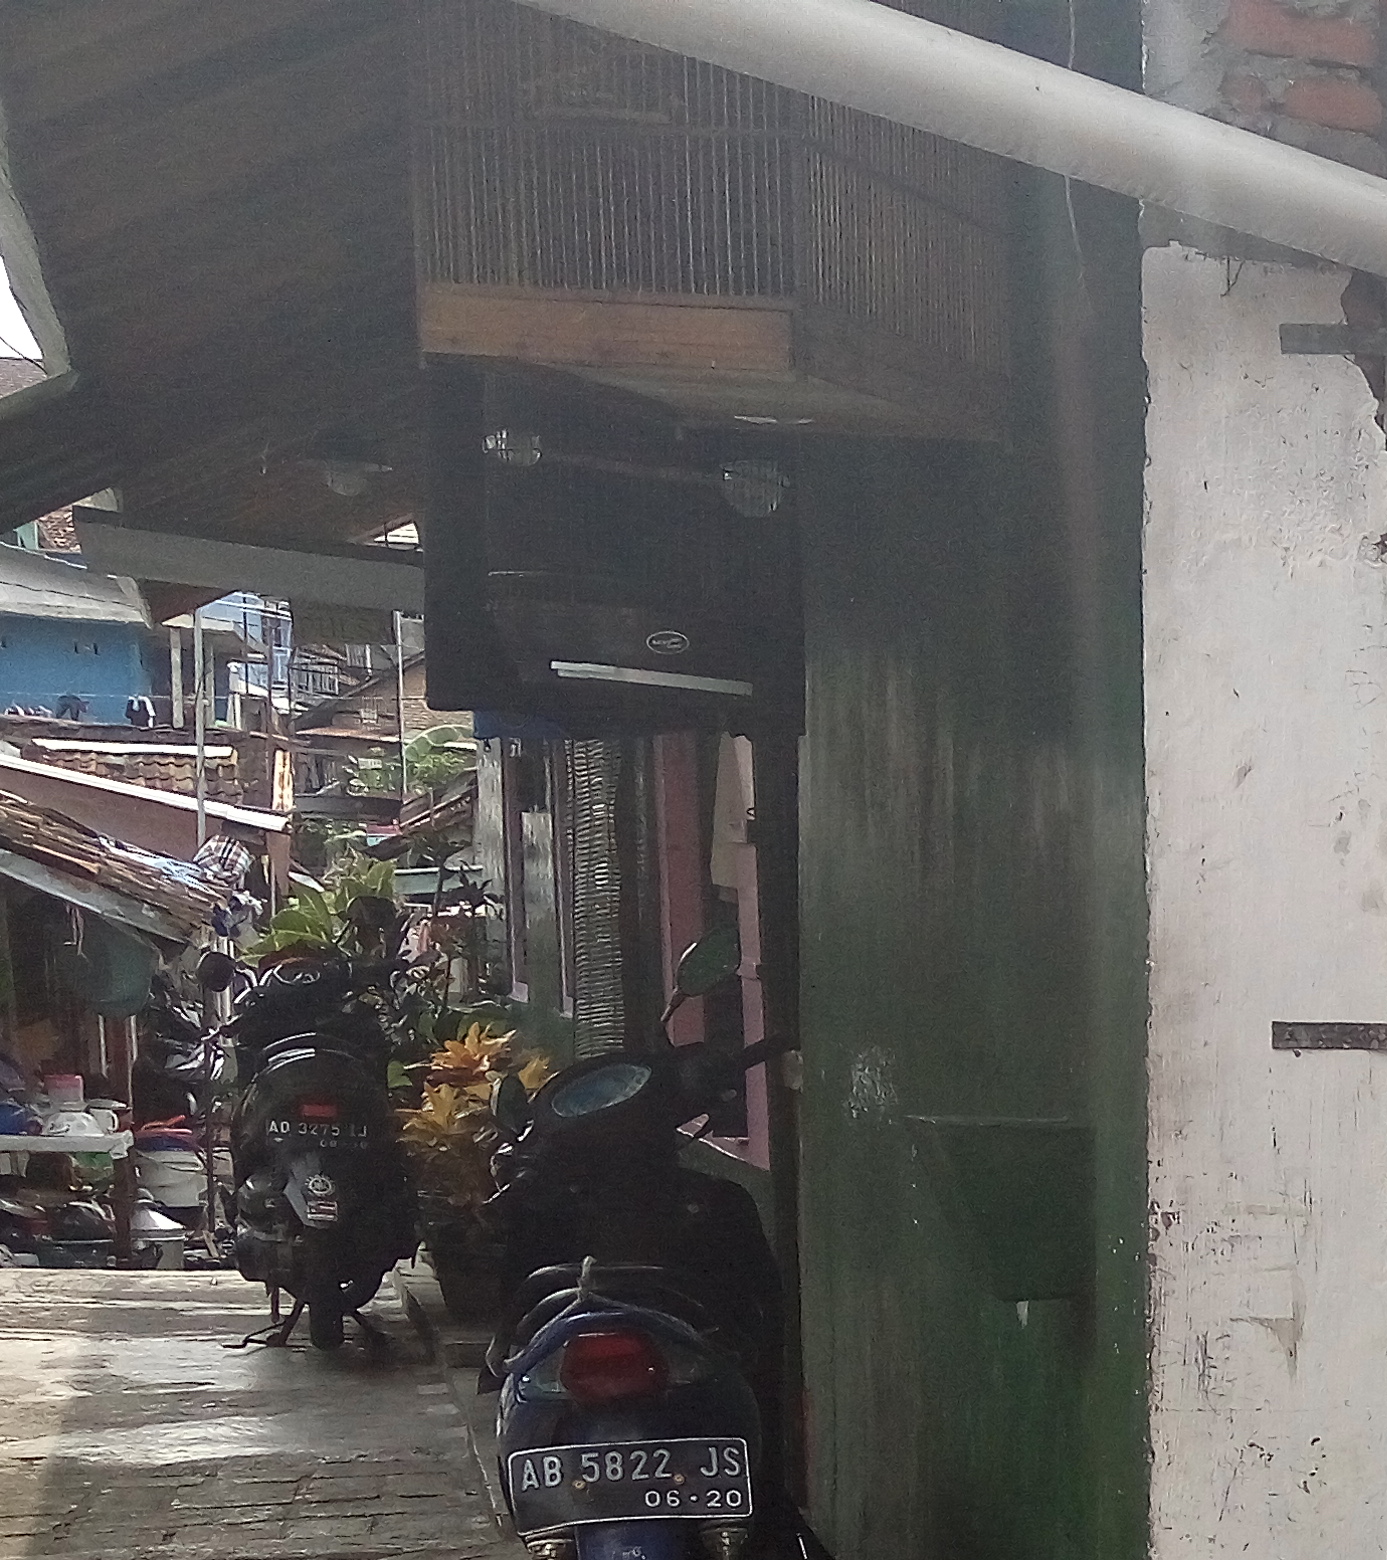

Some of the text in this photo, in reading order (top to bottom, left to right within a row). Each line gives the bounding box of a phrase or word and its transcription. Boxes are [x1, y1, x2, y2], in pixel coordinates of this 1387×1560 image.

[521, 1446, 742, 1492] AB 5822 JS
